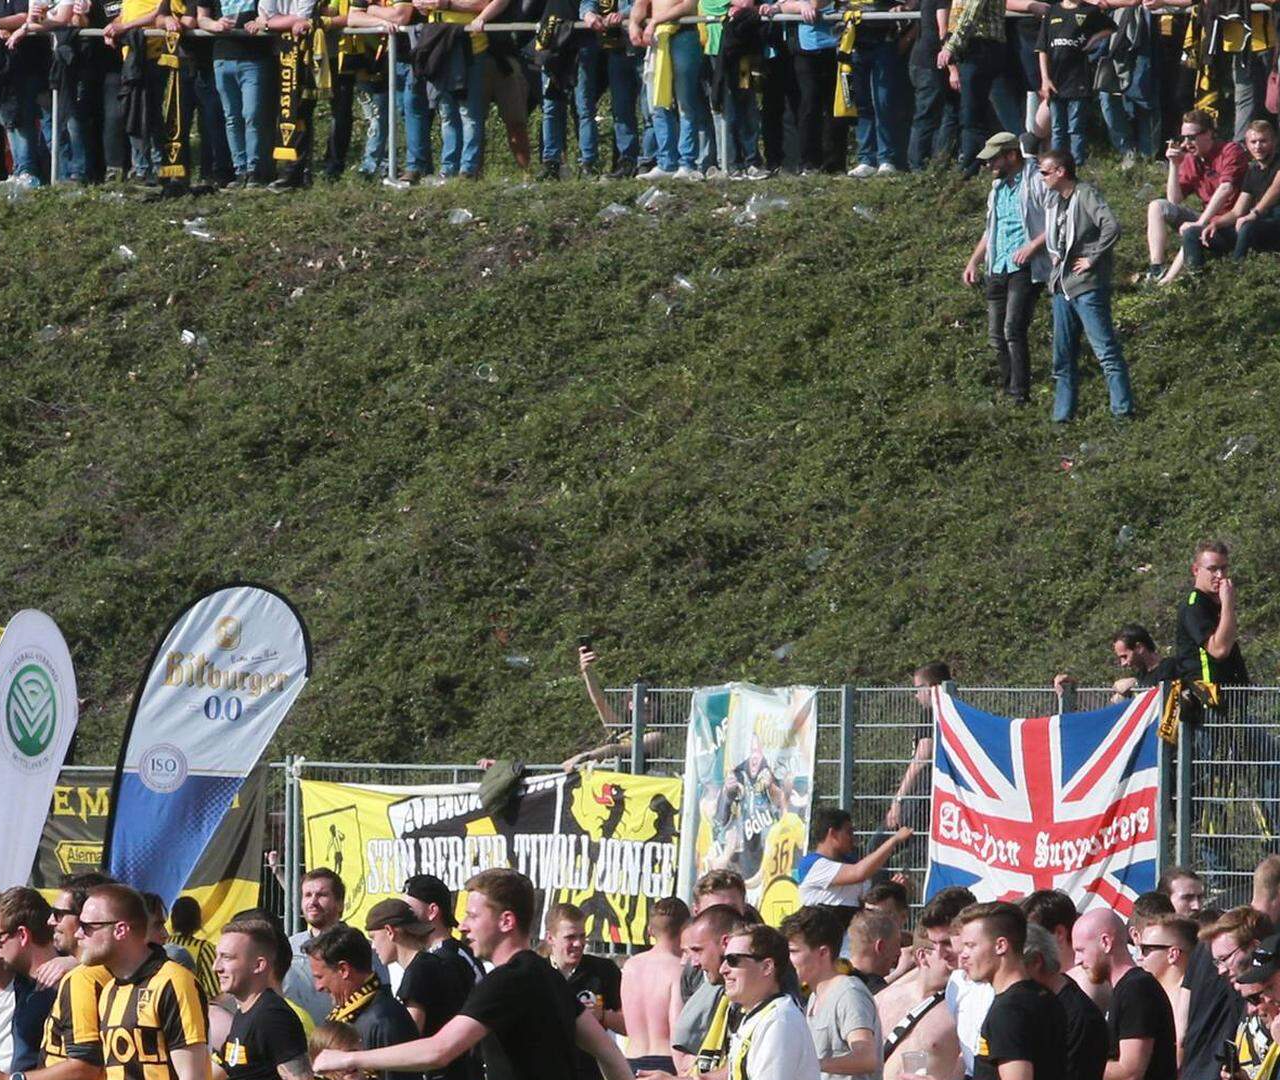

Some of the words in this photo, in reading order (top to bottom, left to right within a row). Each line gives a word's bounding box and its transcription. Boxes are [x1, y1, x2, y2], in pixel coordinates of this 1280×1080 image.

[165, 651, 289, 697] Bitburger
[151, 758, 177, 771] ISO
[67, 846, 104, 864] Alema
